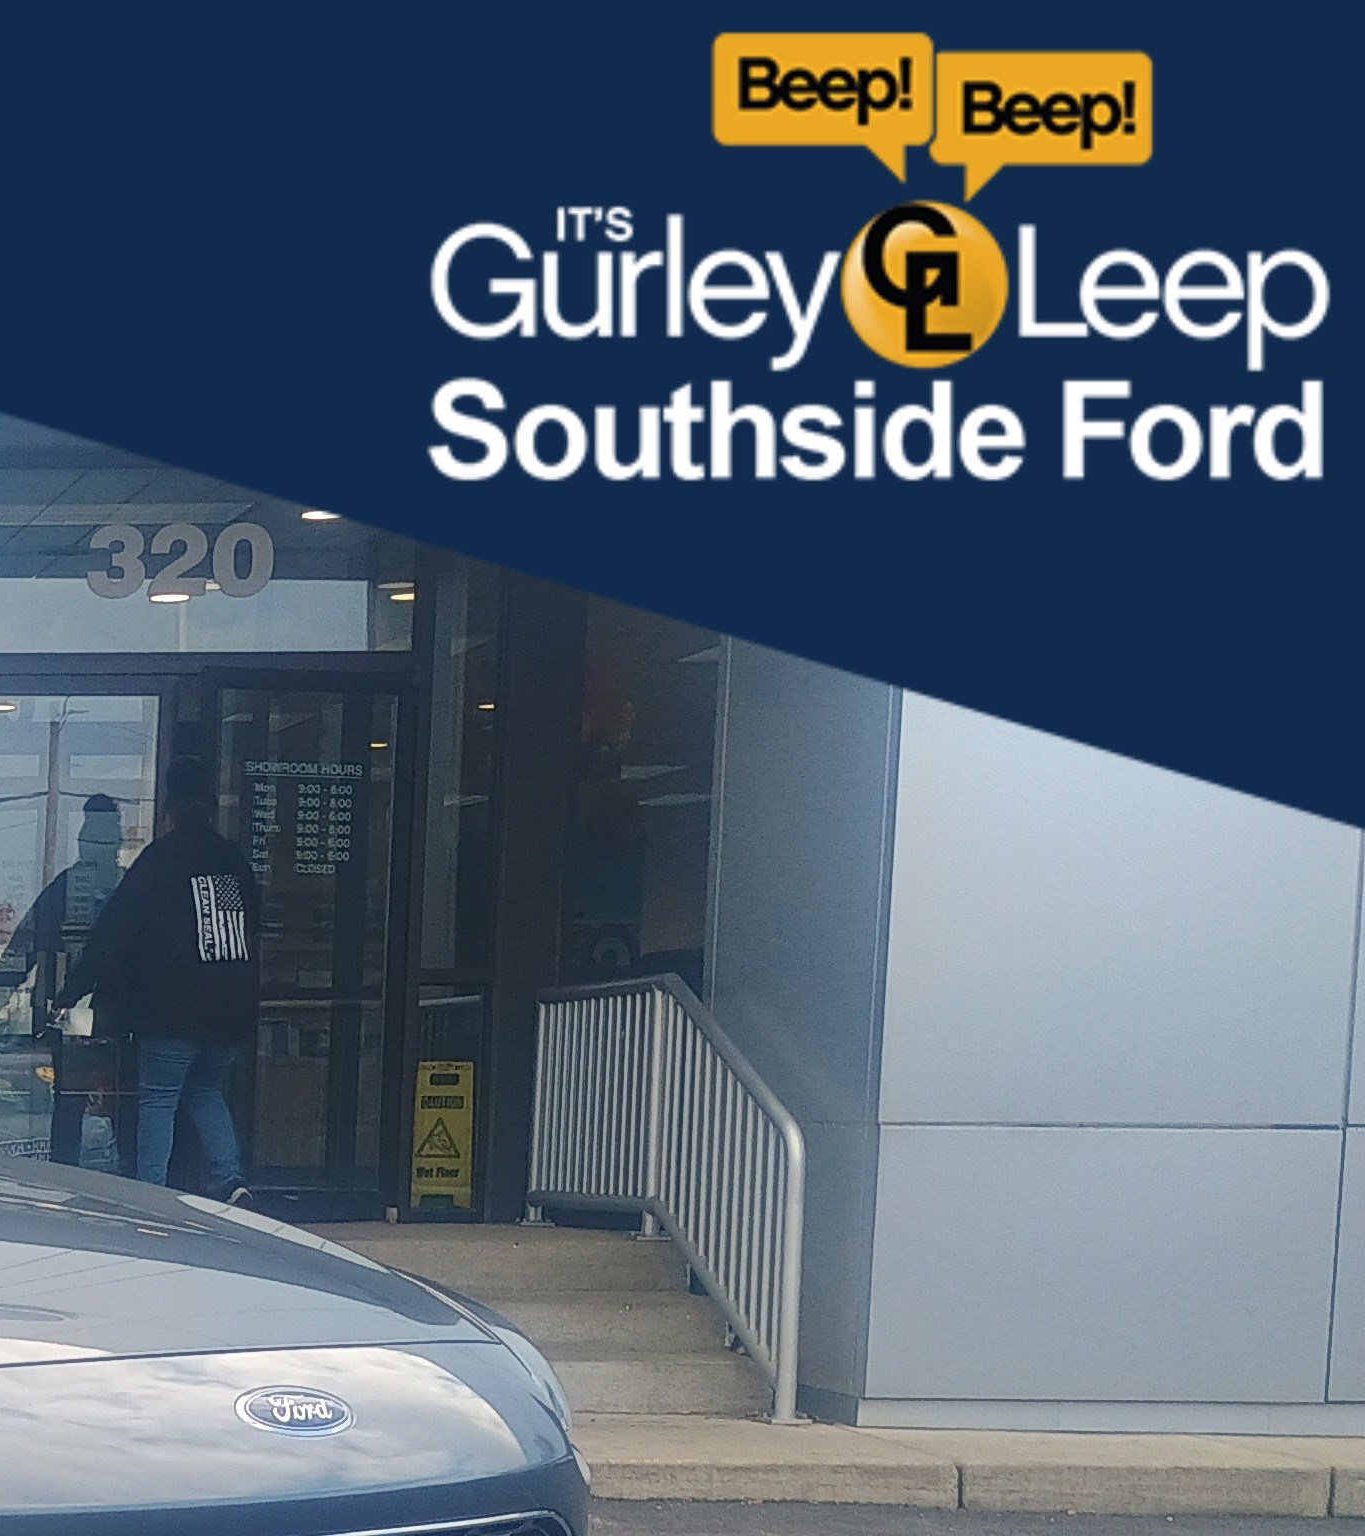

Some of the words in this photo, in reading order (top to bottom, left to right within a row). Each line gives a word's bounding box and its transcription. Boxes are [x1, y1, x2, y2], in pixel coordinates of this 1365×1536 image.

[87, 522, 275, 600] 320
[244, 760, 317, 775] SHOWROOM
[321, 763, 363, 776] HOURS
[253, 783, 276, 793] Mon
[252, 836, 266, 846] Fri
[295, 864, 336, 874] CLOSED
[197, 876, 211, 914] CLEAN
[268, 1394, 333, 1423] Ford
